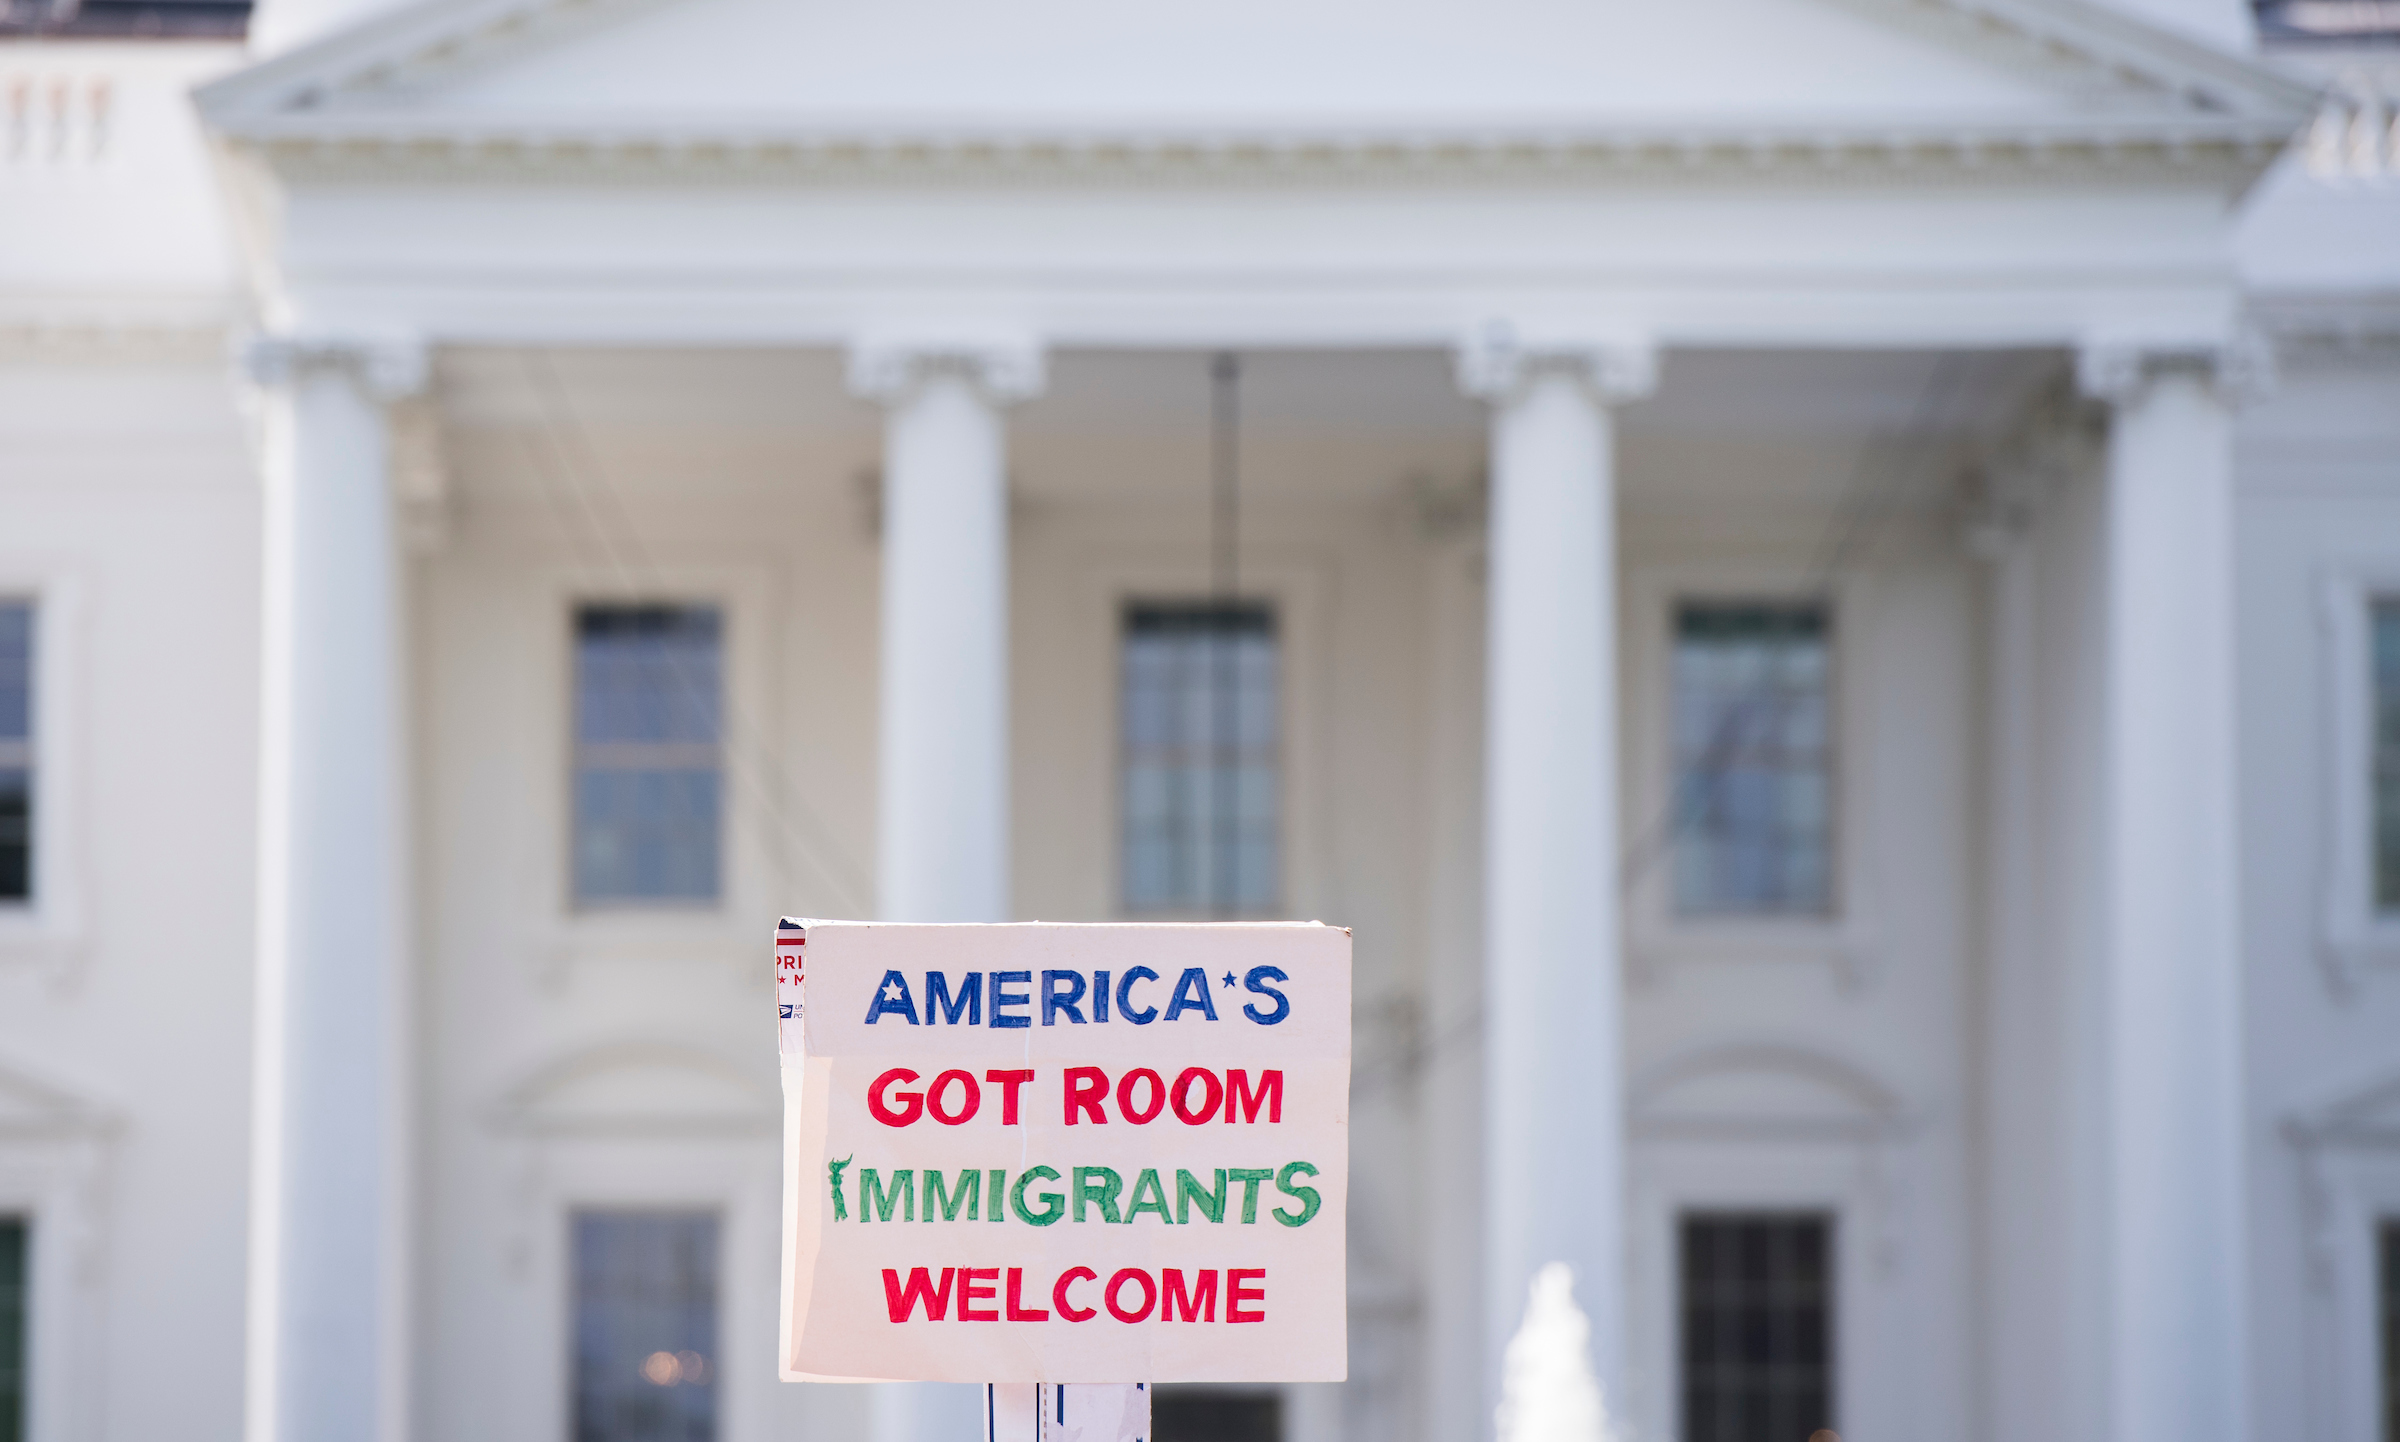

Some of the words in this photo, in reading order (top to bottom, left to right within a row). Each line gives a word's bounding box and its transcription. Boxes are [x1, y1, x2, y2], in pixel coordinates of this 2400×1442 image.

[867, 1068, 1035, 1127] GOT
[1063, 1067, 1284, 1126] ROOM
[829, 1154, 1321, 1227] IMMIGRANTS
[882, 1266, 1266, 1324] WELCOME
